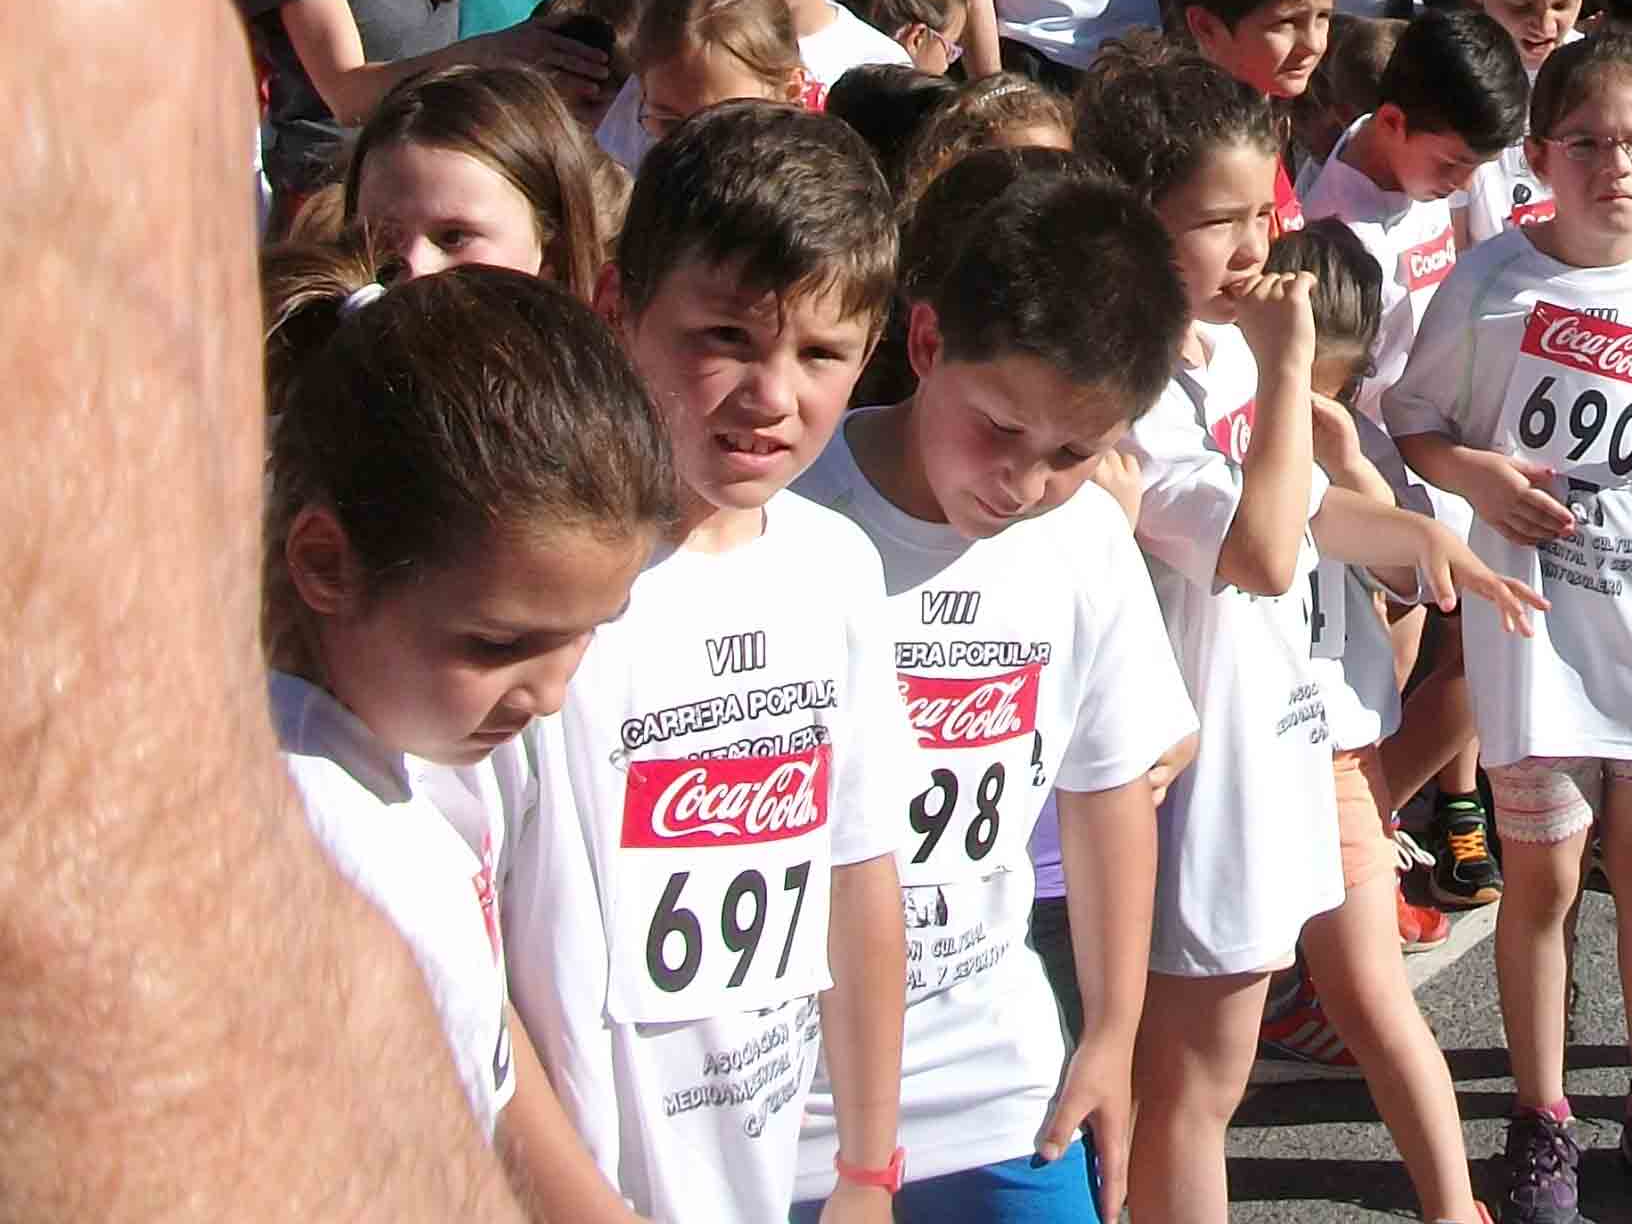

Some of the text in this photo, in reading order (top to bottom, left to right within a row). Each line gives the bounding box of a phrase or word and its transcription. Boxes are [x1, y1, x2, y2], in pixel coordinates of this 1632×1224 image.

[922, 591, 981, 624] VIII
[705, 630, 767, 677] VIII
[949, 641, 1052, 668] POPULAR
[620, 692, 744, 751] CARRERA
[651, 760, 822, 839] Coca-Cola
[645, 859, 812, 993] 697
